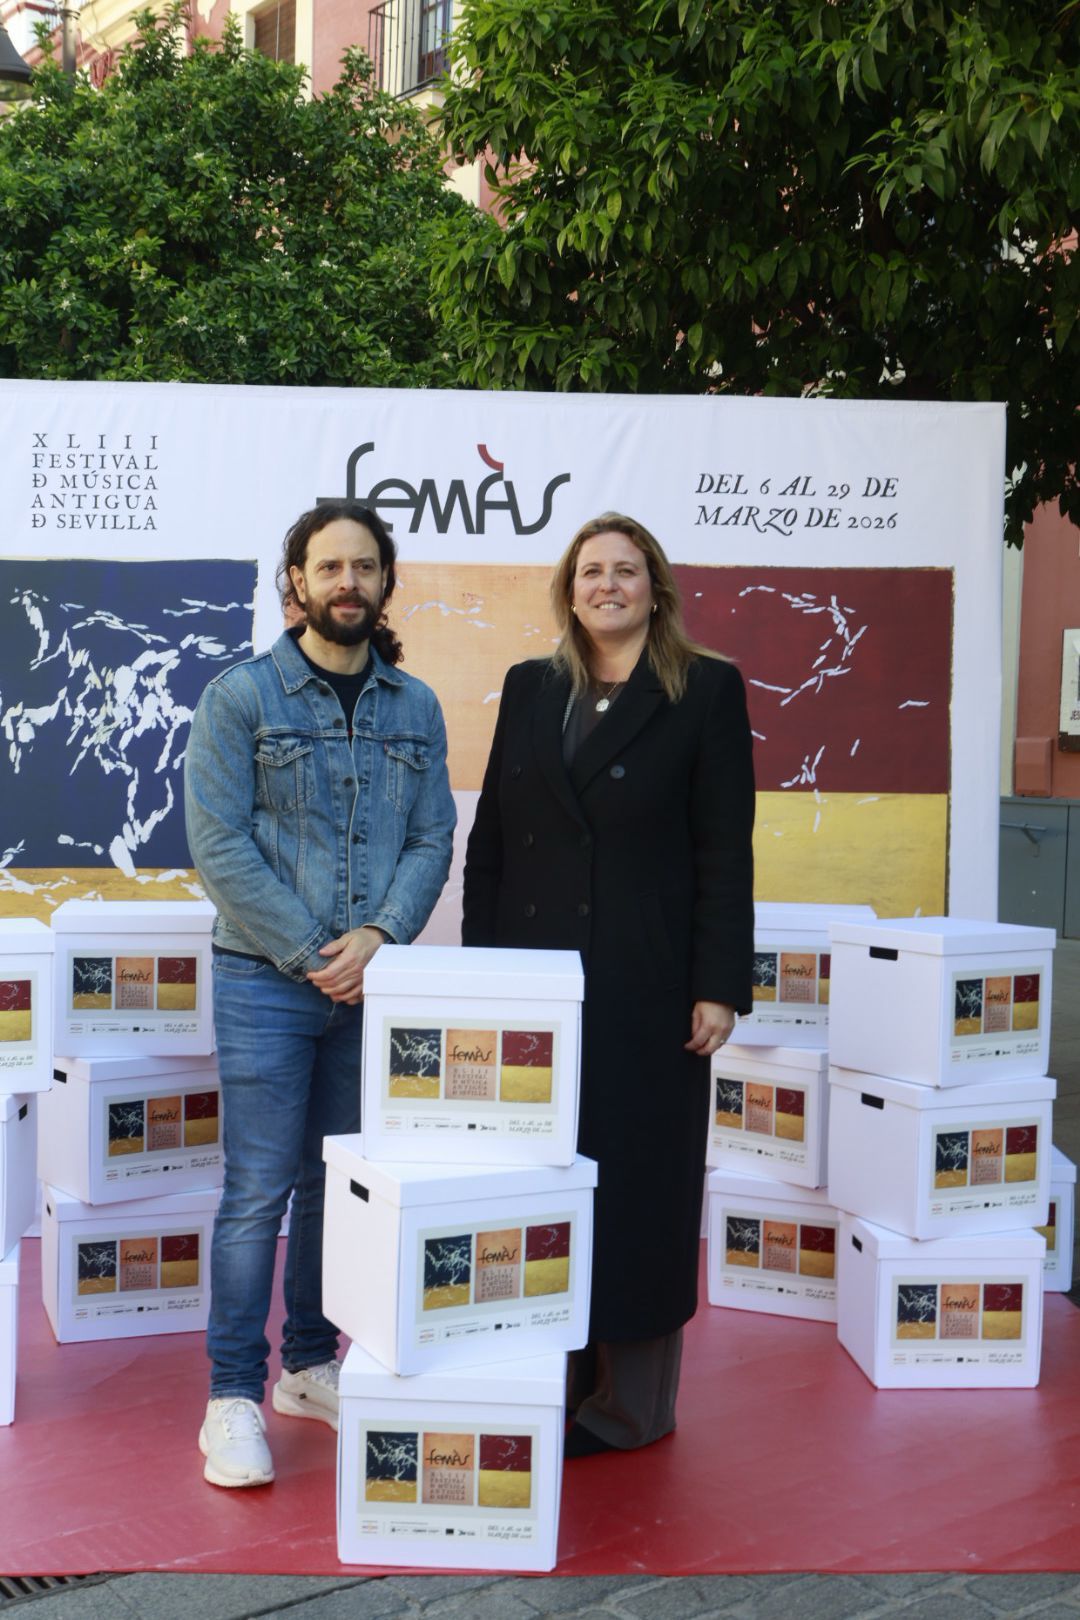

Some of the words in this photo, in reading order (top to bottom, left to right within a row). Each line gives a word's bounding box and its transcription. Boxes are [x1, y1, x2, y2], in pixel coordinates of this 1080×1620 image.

[32, 453, 158, 470] FESTIVAL
[60, 470, 158, 490] MÚSICA
[695, 473, 748, 494] DEL
[760, 478, 771, 494] 6
[778, 476, 816, 497] AL
[828, 483, 850, 499] 29
[862, 477, 898, 497] DE
[31, 493, 158, 510] ANTIGUA
[56, 514, 157, 530] SEVILLA
[694, 506, 798, 536] MARZO
[804, 508, 842, 528] DE
[848, 512, 898, 529] 2026
